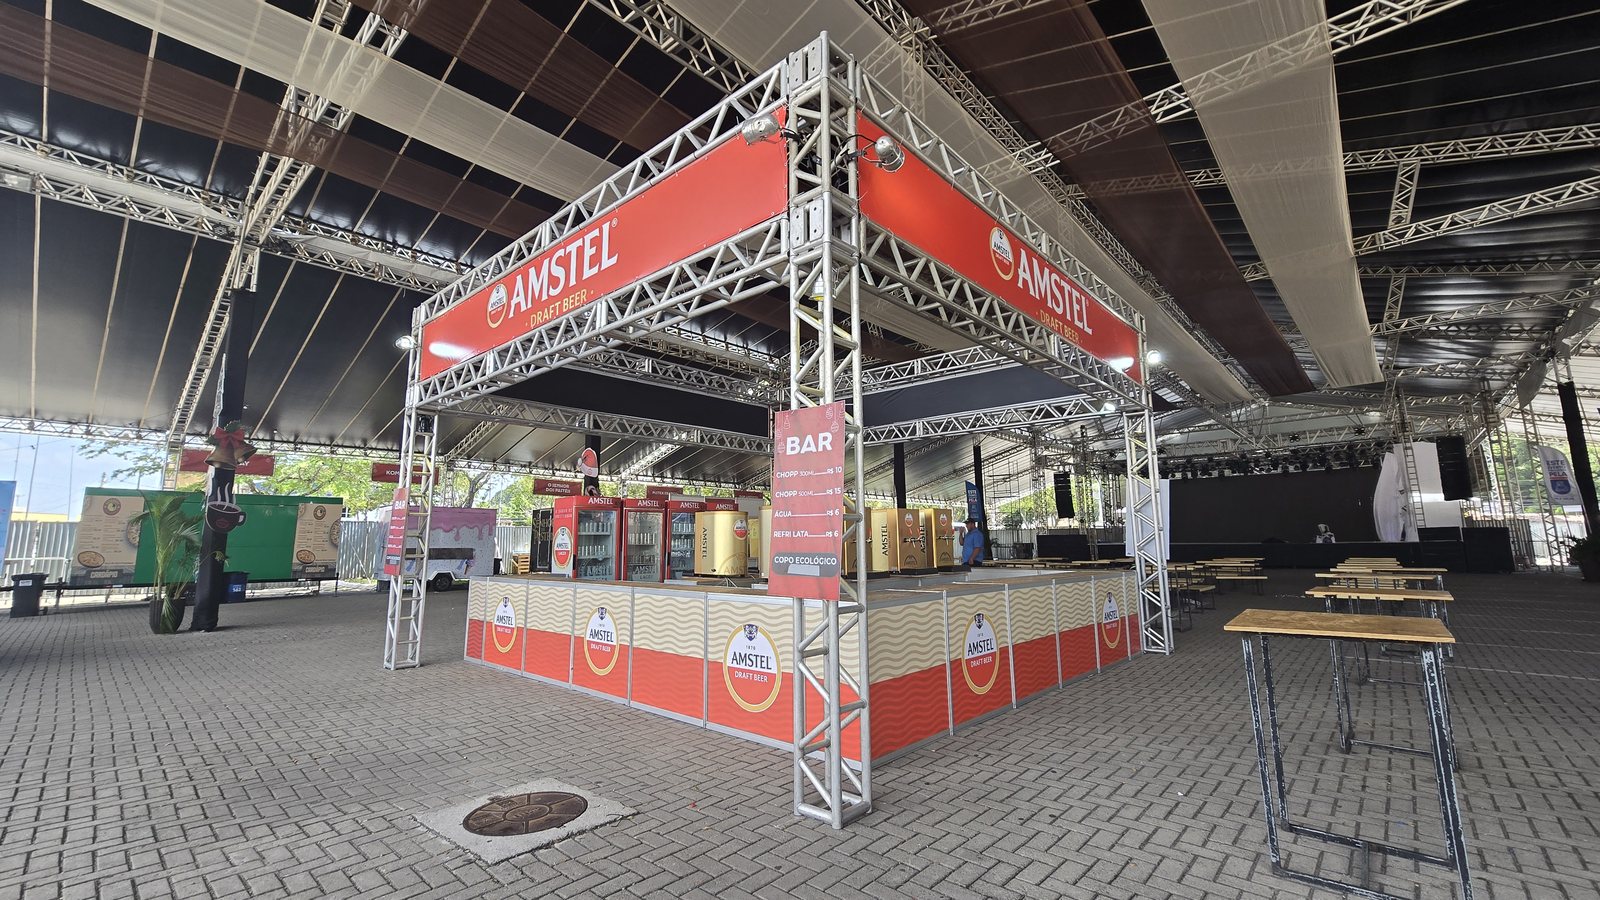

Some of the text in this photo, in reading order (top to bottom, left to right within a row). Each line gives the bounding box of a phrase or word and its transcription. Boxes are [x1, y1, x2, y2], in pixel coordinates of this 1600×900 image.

[1017, 248, 1093, 335] AMSTEL
[530, 289, 587, 328] DRAFT BEER
[1040, 309, 1079, 343] DRAFT BEER
[786, 432, 832, 455] BAR
[774, 510, 792, 518] ÁGUA
[774, 555, 837, 565] COPO ECOLÓGICO
[496, 615, 514, 626] AMSTEL
[588, 628, 614, 642] AMSTEL
[968, 638, 994, 656] AMSTEL
[731, 652, 772, 670] AMSTEL
[970, 656, 992, 668] DRAFT BEER
[734, 671, 768, 682] DRAFT BEER
